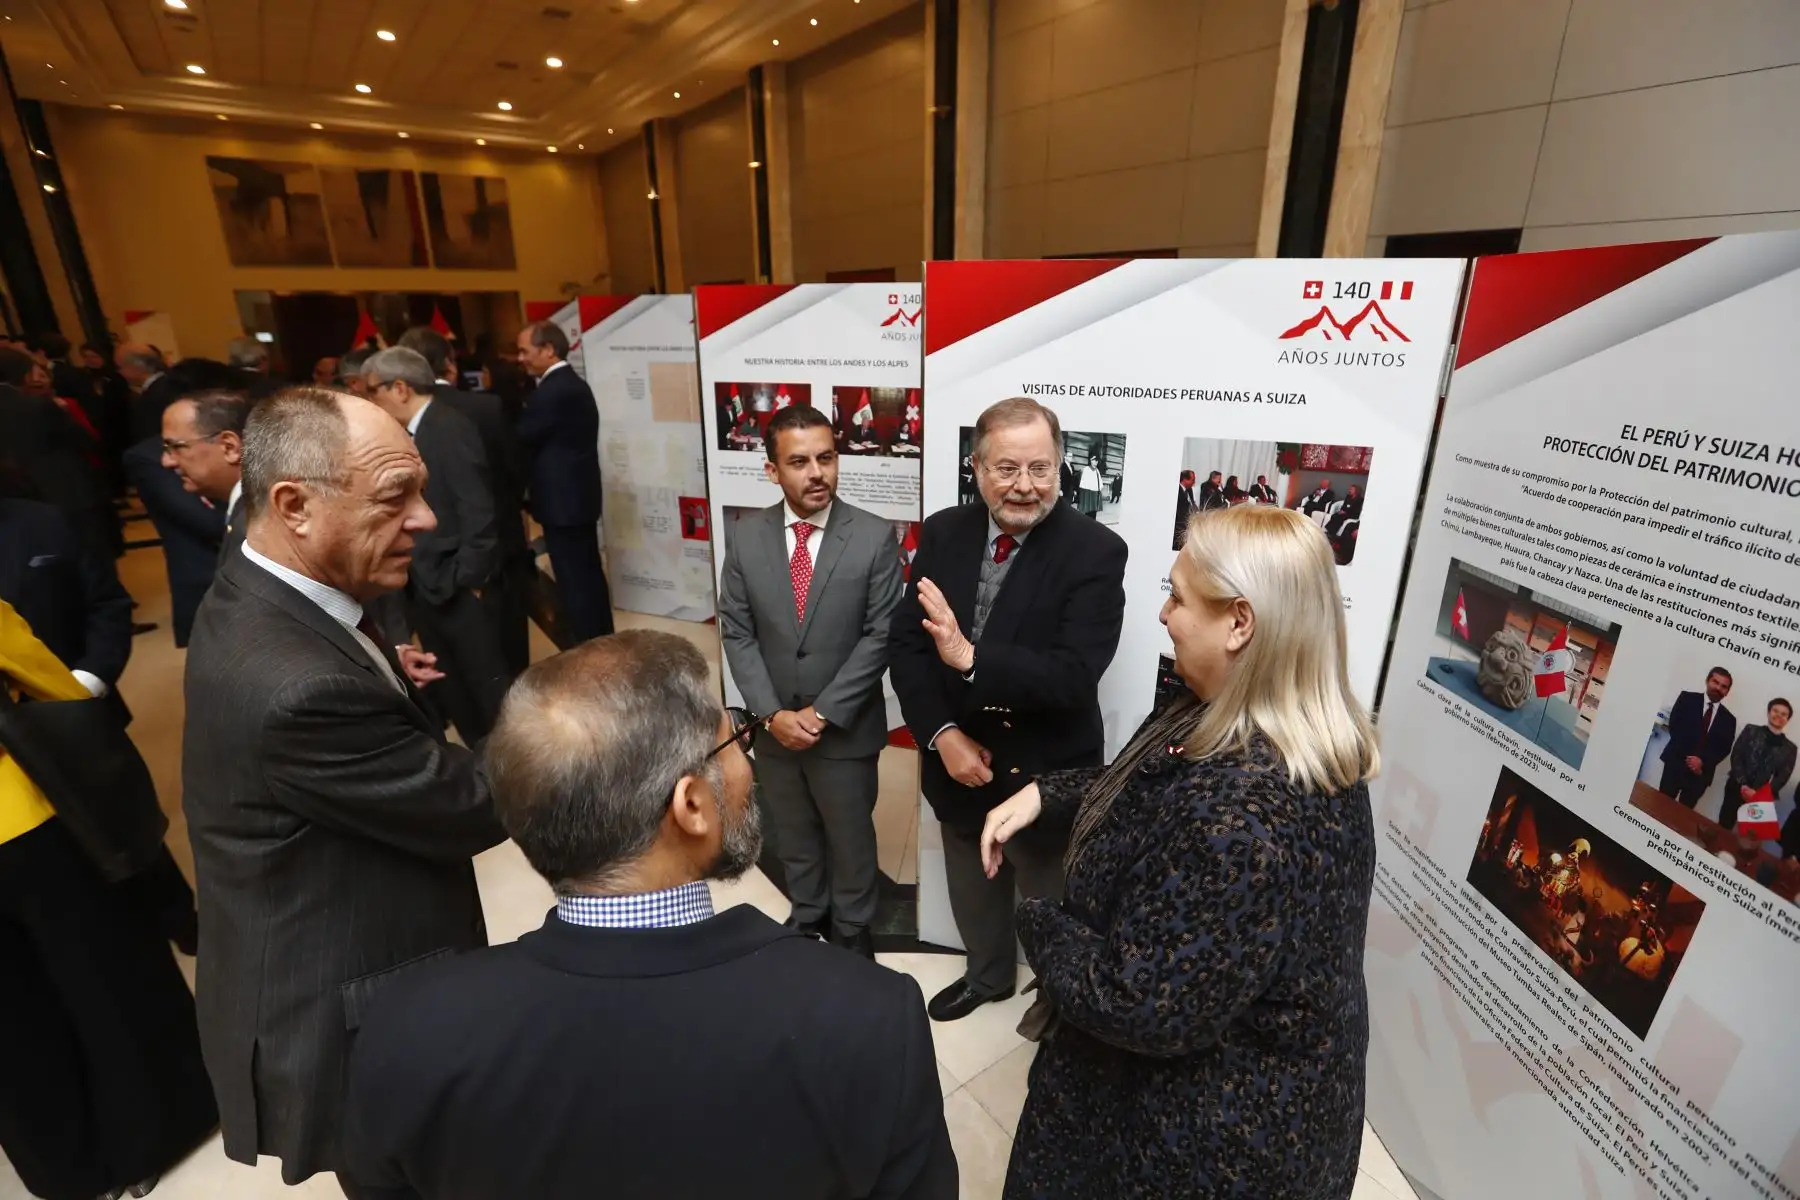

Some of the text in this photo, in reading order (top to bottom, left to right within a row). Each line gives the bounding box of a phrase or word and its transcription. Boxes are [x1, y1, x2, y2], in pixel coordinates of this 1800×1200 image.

[1333, 281, 1371, 299] 140
[807, 358, 827, 366] ENTRE
[843, 359, 866, 367] ANDES
[1022, 383, 1307, 405] VISITAS DE AUTORIDADES PERUANAS A SUIZA
[1278, 348, 1406, 367] AÑOS JUNTOS
[1543, 435, 1800, 497] PROTECCIÓN DEL PATRIMONIO
[1621, 424, 1638, 441] EL
[1642, 427, 1690, 449] PERÚ
[1694, 434, 1707, 451] Y
[1707, 437, 1769, 462] SUIZA
[1455, 453, 1473, 465] Como
[1473, 459, 1500, 471] muestra
[1501, 464, 1510, 474] de
[1511, 468, 1521, 476] su
[1521, 471, 1570, 488] compromiso
[1570, 482, 1587, 492] por
[1588, 484, 1597, 495] la
[1599, 487, 1649, 507] Protección
[1652, 500, 1670, 512] del
[1670, 506, 1736, 528] patrimonio
[1739, 522, 1792, 543] cultural,
[1555, 494, 1567, 504] de
[1567, 499, 1622, 519] cooperación
[1622, 513, 1646, 525] para
[1647, 517, 1690, 536] impedir
[1691, 529, 1703, 540] el
[1704, 532, 1743, 550] tráfico
[1744, 542, 1782, 560] ilícito
[1461, 526, 1503, 549] Lambayeque,
[1503, 541, 1531, 559] Huaura,
[1533, 552, 1567, 572] Chancay
[1566, 565, 1573, 575] y
[1574, 566, 1602, 584] Nazca.
[1604, 576, 1623, 591] Una
[1625, 584, 1638, 597] de
[1639, 588, 1654, 602] las
[1656, 597, 1728, 628] restituciones
[1730, 623, 1757, 638] más
[1479, 517, 1501, 532] bienes
[1501, 527, 1536, 544] culturales
[1536, 537, 1555, 550] tales
[1555, 545, 1579, 558] como
[1578, 552, 1608, 568] piezas
[1608, 561, 1621, 573] de
[1621, 567, 1666, 587] cerámica
[1667, 582, 1675, 590] e
[1675, 582, 1754, 616] instrumentos
[1756, 609, 1799, 631] textile
[1493, 509, 1524, 524] conjunta
[1525, 517, 1535, 528] de
[1535, 522, 1562, 536] ambos
[1563, 531, 1609, 552] gobiernos,
[1610, 545, 1626, 556] así
[1625, 550, 1654, 565] como
[1655, 556, 1665, 568] la
[1668, 562, 1719, 584] voluntad
[1720, 577, 1736, 590] de
[1500, 557, 1515, 568] país
[1515, 560, 1528, 573] fue
[1528, 565, 1536, 576] la
[1536, 571, 1564, 587] cabeza
[1564, 580, 1587, 595] clava
[1587, 590, 1654, 621] perteneciente
[1655, 615, 1662, 623] a
[1663, 615, 1674, 628] la
[1675, 623, 1715, 643] cultura
[1717, 637, 1760, 660] Chavín
[1763, 655, 1780, 668] en
[1613, 805, 1660, 840] Ceremonia
[1663, 839, 1682, 853] por
[1684, 850, 1694, 862] la
[1698, 860, 1756, 902] restitución
[1760, 901, 1773, 912] al
[1646, 839, 1715, 887] prehispánicos
[1716, 885, 1730, 898] en
[1732, 893, 1763, 919] Suiza
[1464, 907, 1485, 930] Fondo
[1494, 936, 1535, 977] Contravalor
[1534, 974, 1577, 1020] Suiza-Perú,
[1587, 1026, 1607, 1047] cual
[1606, 1044, 1648, 1085] permitió
[1659, 1093, 1727, 1160] financiación
[1484, 912, 1498, 926] por
[1511, 938, 1559, 985] preservación
[1564, 987, 1579, 1002] del
[1582, 1004, 1633, 1053] patrimonio
[1640, 1057, 1680, 1096] cultural
[1685, 1099, 1736, 1147] peruano
[1489, 946, 1512, 972] Museo
[1513, 968, 1540, 1000] Tumbas
[1541, 997, 1566, 1026] Reales
[1579, 1034, 1606, 1065] Sipán,
[1607, 1061, 1664, 1119] inaugurado
[1665, 1119, 1679, 1134] en
